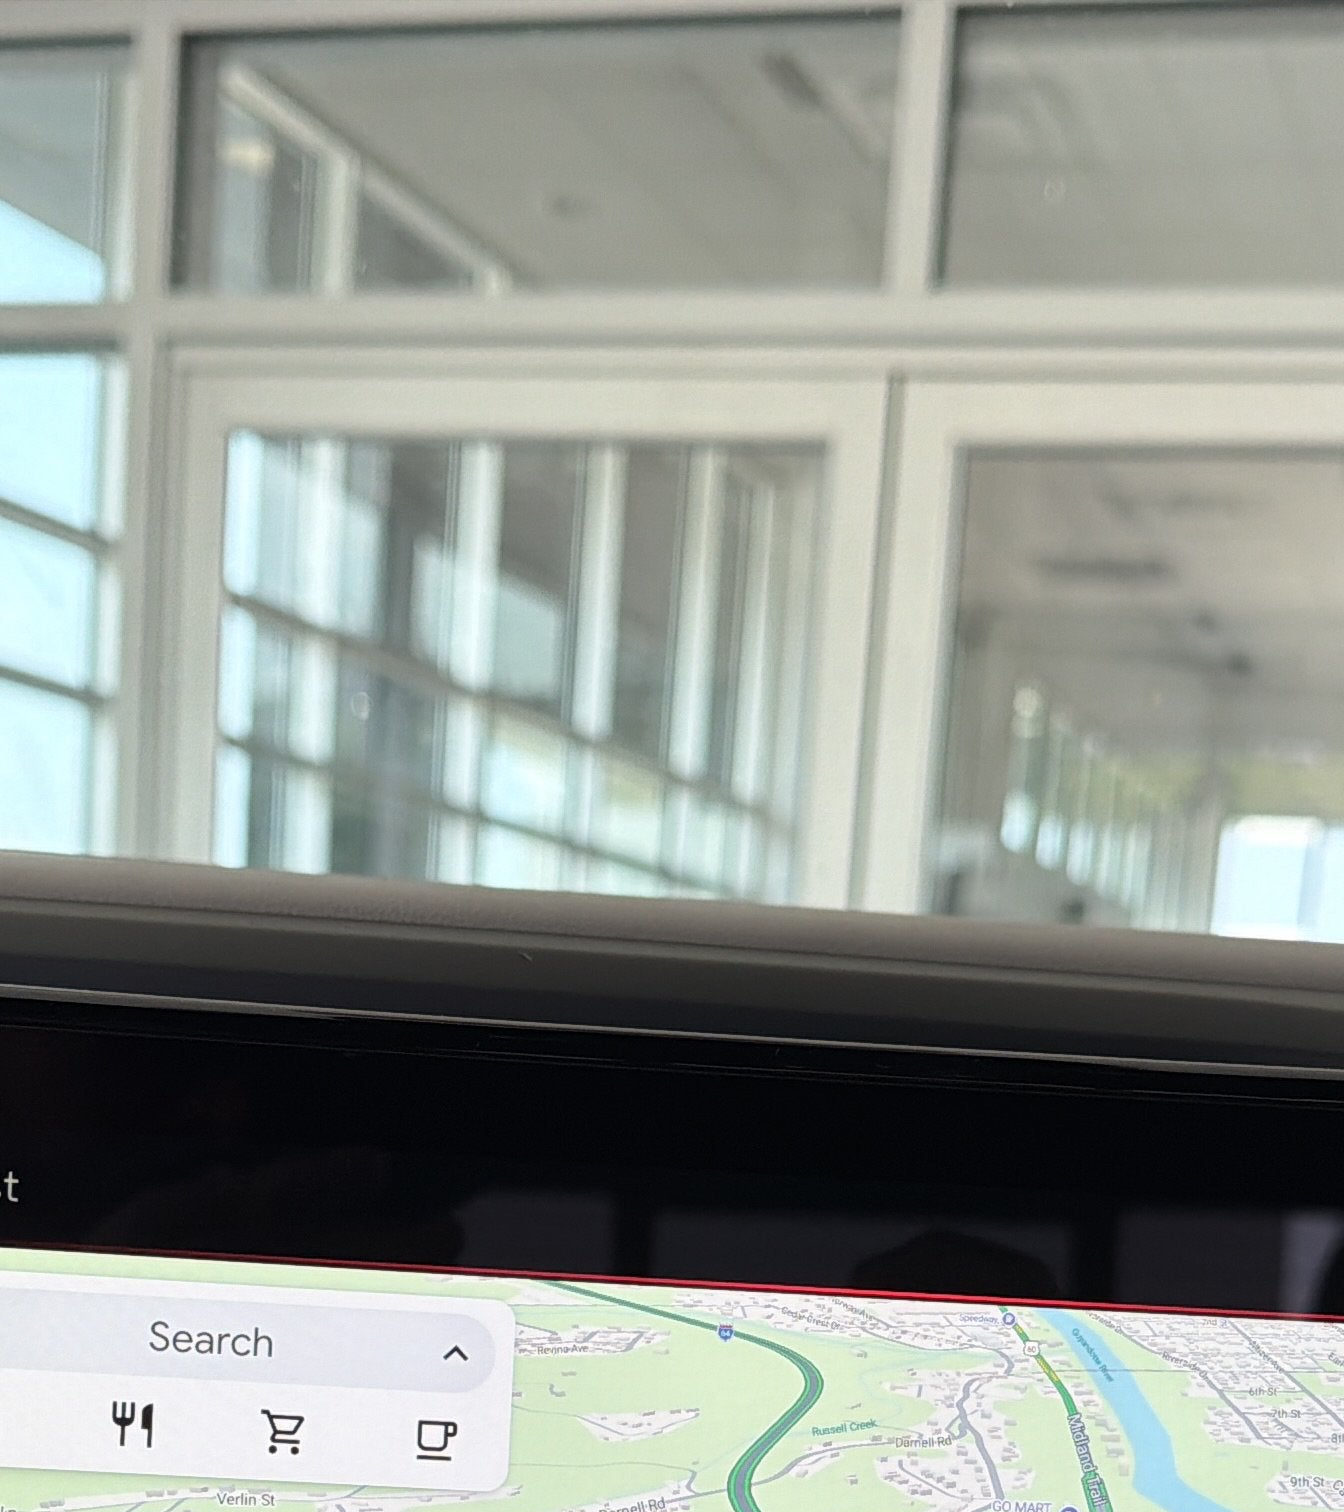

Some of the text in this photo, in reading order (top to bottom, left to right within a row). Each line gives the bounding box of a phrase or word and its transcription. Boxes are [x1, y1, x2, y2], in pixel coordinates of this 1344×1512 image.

[148, 1320, 274, 1359] Search
[1249, 1387, 1277, 1396] 6th St
[1271, 1409, 1301, 1419] 7th St
[811, 1418, 878, 1437] Russell Creek
[895, 1435, 952, 1450] Darnell Rd
[1067, 1412, 1107, 1506] Midland Trail
[1290, 1476, 1325, 1489] 9th St
[216, 1491, 275, 1507] Verlin St
